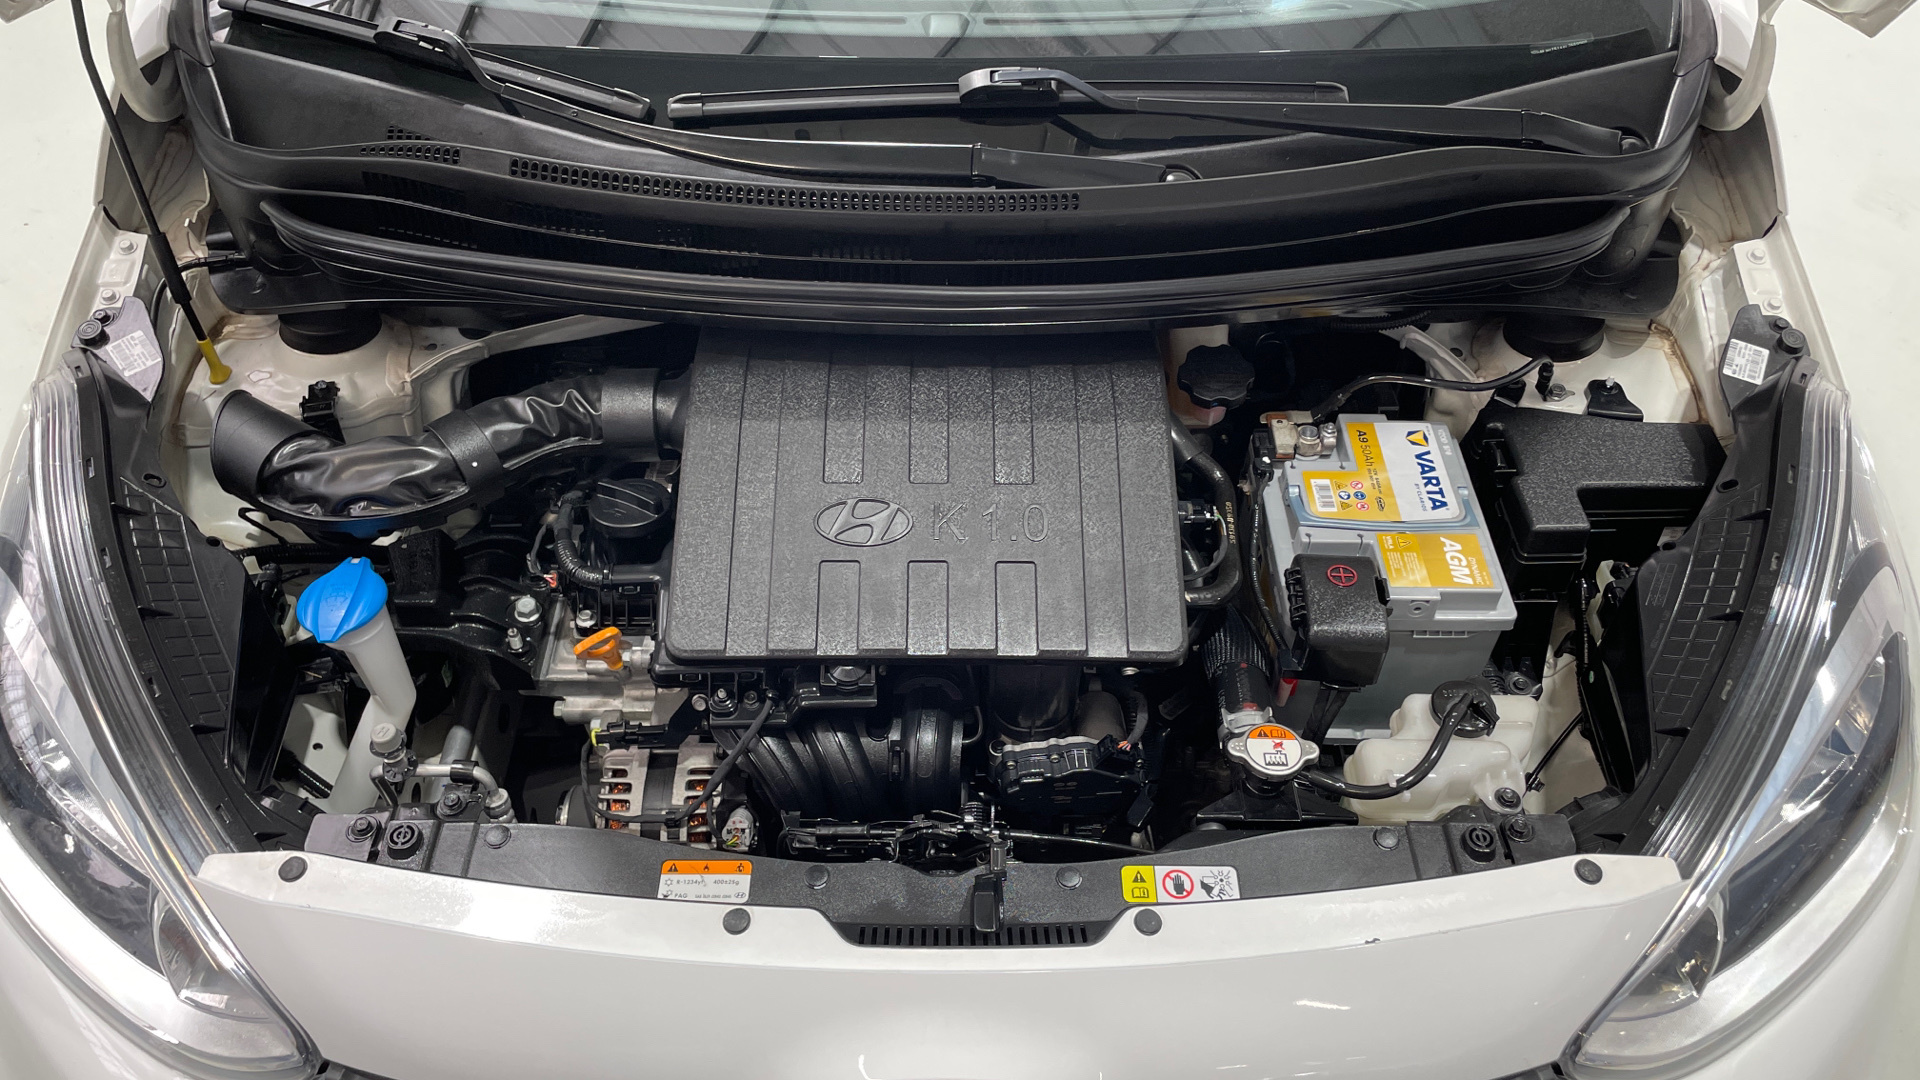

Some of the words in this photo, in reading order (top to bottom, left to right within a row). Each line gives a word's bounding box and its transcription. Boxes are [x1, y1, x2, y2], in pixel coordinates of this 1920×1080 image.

[1356, 429, 1368, 443] A9
[1360, 444, 1375, 467] 50Ah
[1414, 450, 1448, 511] VARTA
[1415, 491, 1428, 512] CLARIOS
[932, 501, 968, 542] K
[982, 502, 1050, 542] 1.0
[1439, 536, 1474, 585] AGM
[1468, 556, 1483, 586] DYNAMIC
